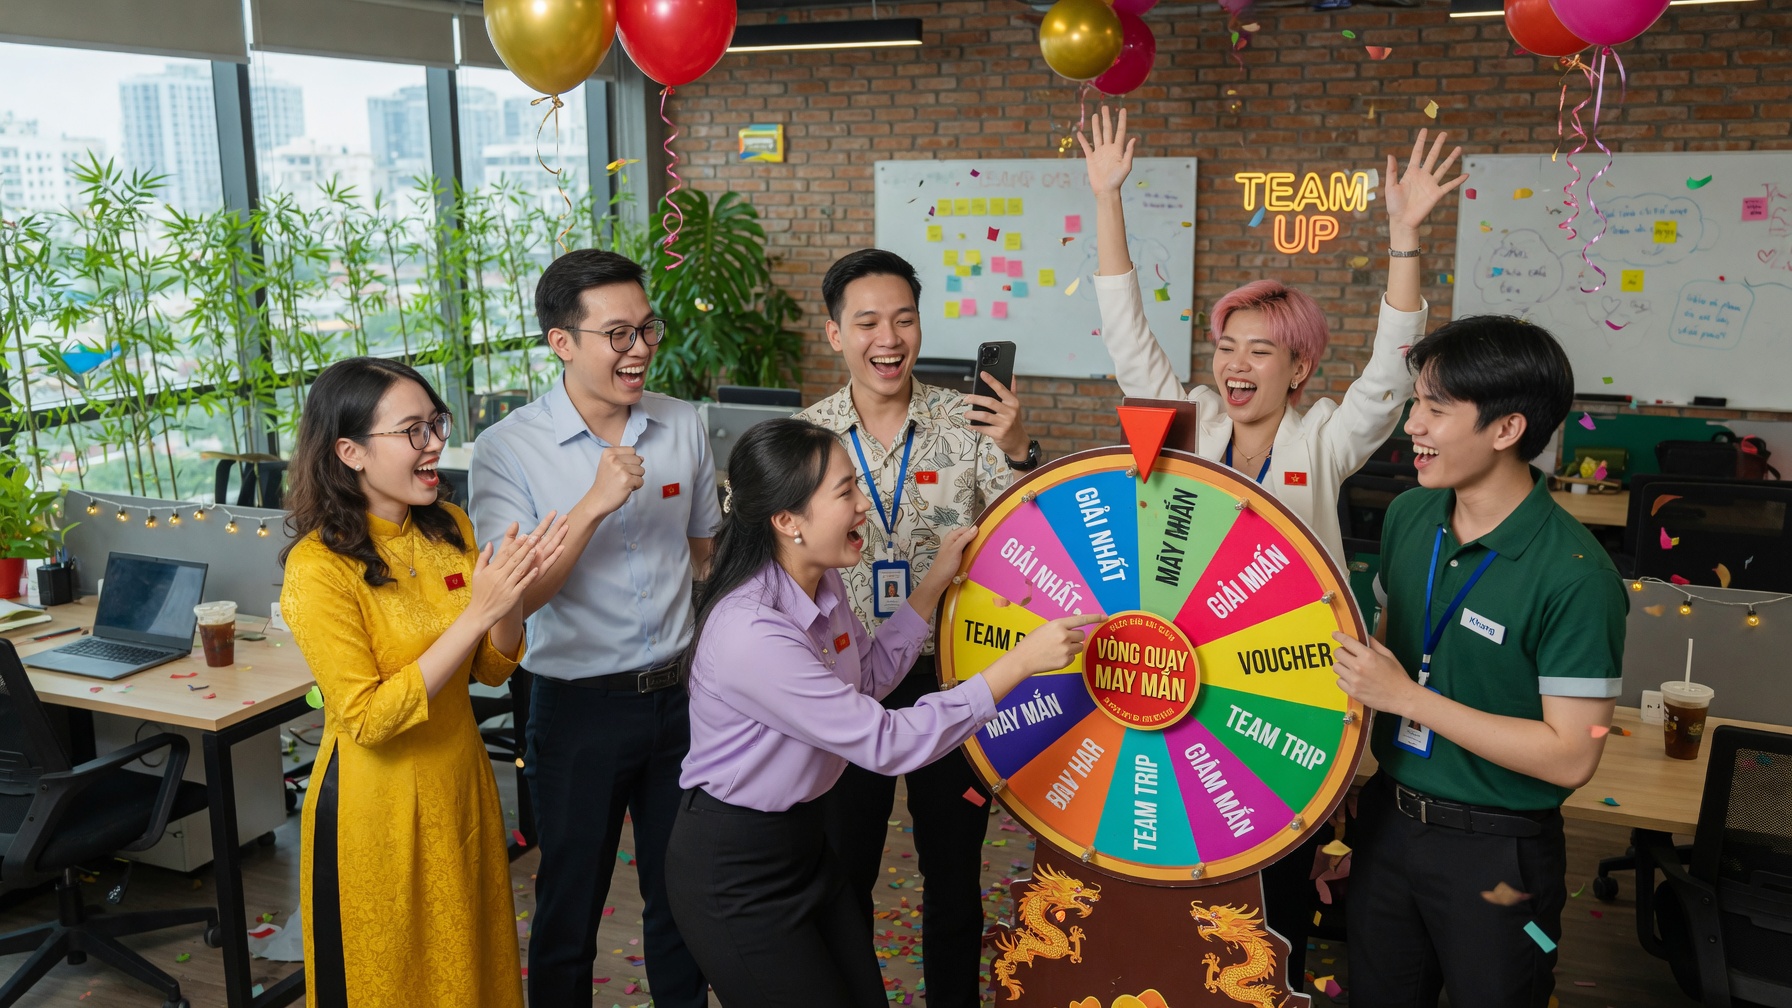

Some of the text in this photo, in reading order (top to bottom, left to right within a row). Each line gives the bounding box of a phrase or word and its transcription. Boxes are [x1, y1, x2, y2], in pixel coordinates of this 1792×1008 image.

[1234, 171, 1369, 213] TEAM
[1273, 214, 1340, 254] UP
[1075, 487, 1111, 528] GIẢI
[1000, 537, 1039, 577] GIẢI
[1206, 580, 1249, 619] GIẢI
[964, 619, 1010, 651] TEAM
[1096, 635, 1189, 672] VÒNG QUAY
[1237, 642, 1334, 675] VOUCHER
[1095, 664, 1186, 703] MAY MẮN
[985, 706, 1020, 739] MAY
[1226, 704, 1327, 771] TEAM TRIP
[1067, 737, 1105, 778] HAR
[1133, 754, 1158, 851] TEAM TRIP
